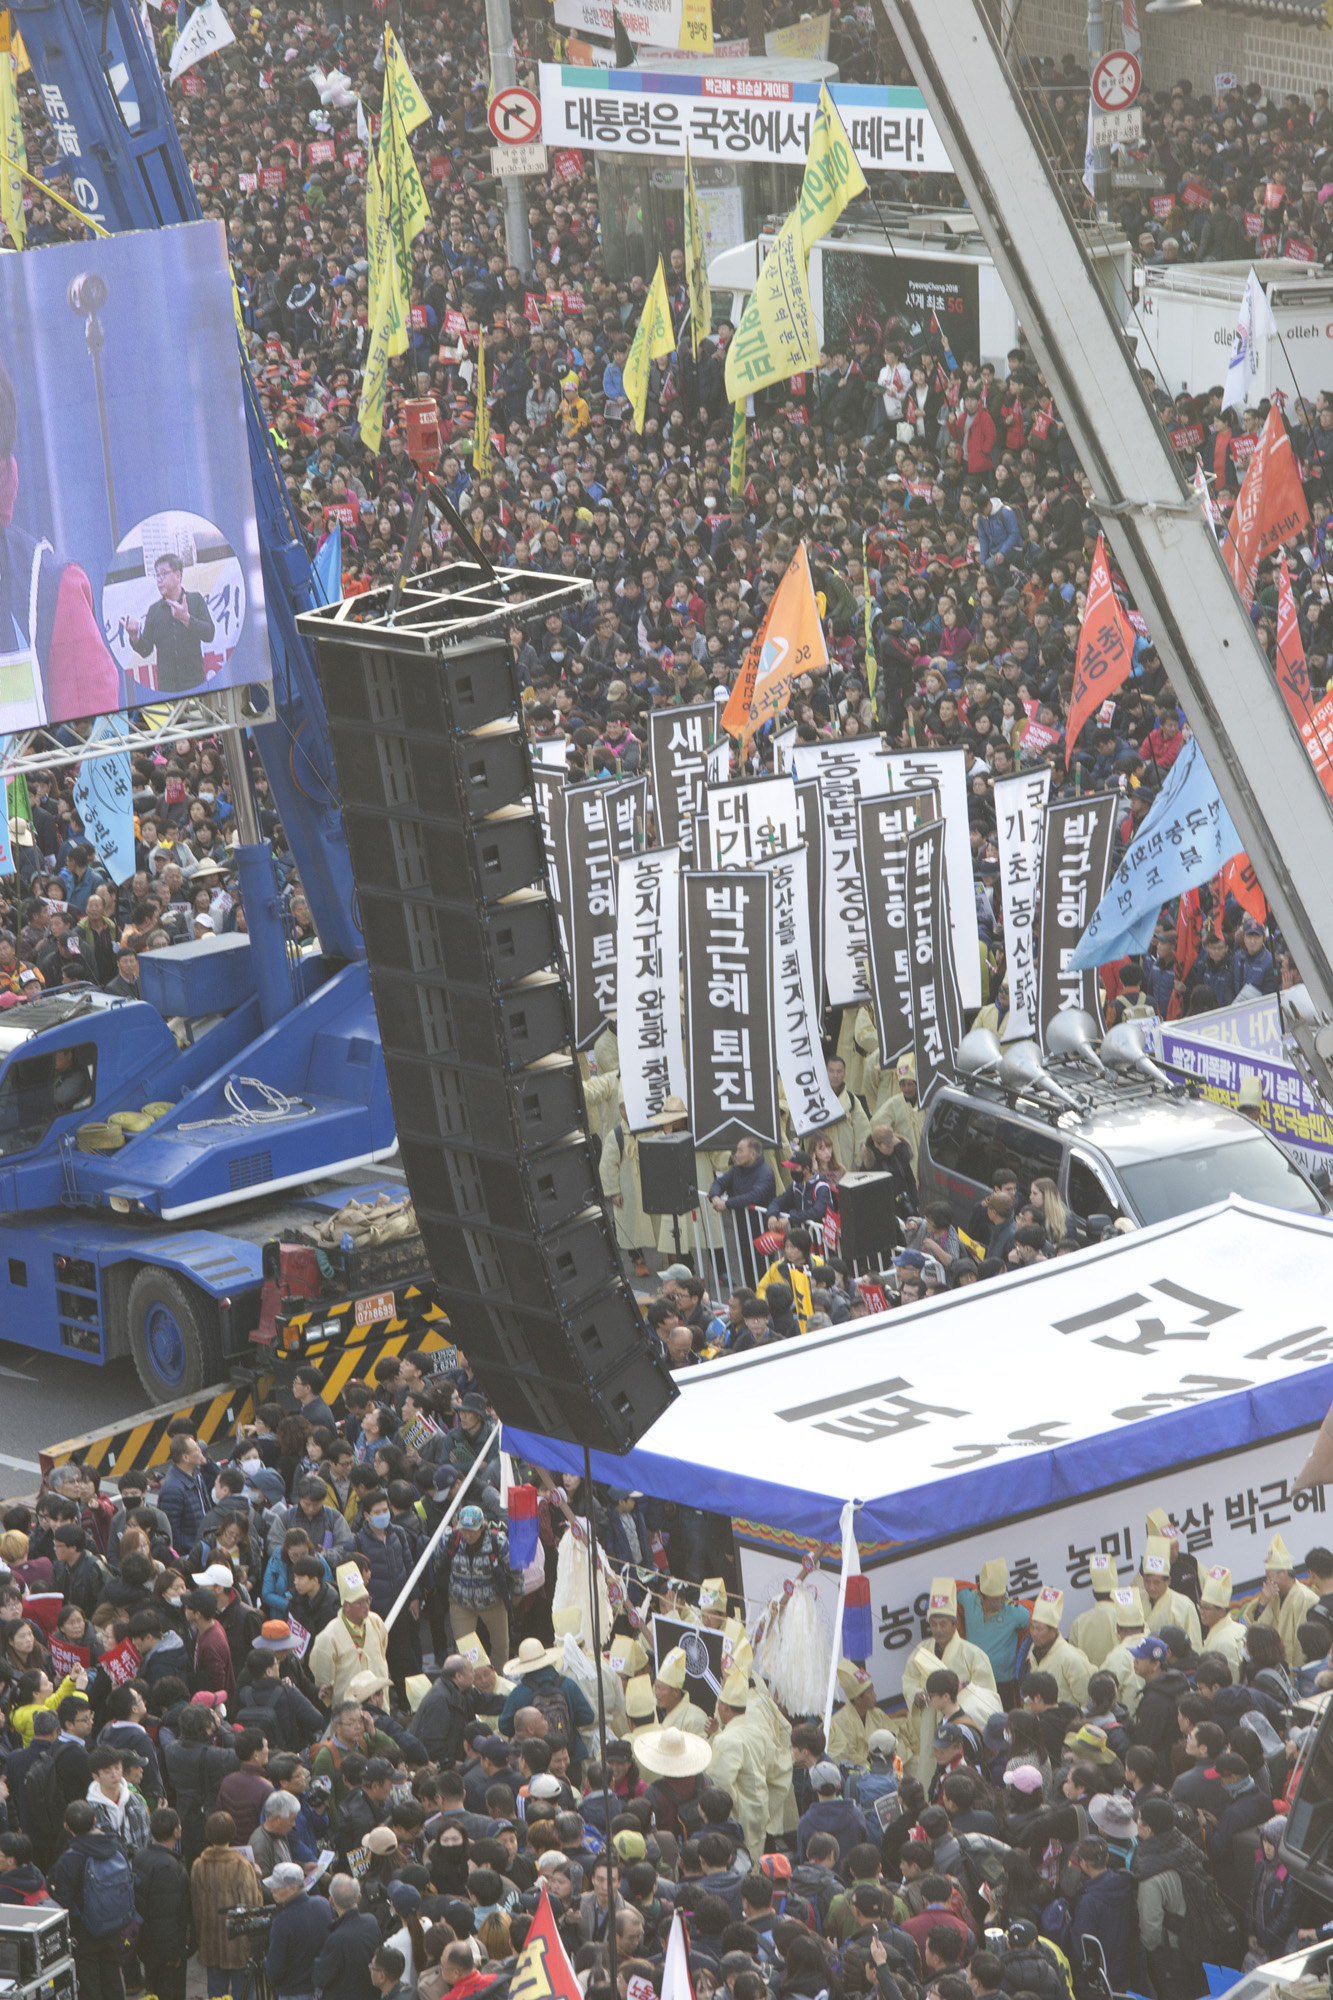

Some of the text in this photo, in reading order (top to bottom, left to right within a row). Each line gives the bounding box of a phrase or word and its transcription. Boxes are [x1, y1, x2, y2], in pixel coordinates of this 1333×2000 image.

[687, 21, 708, 40] 정의당
[763, 82, 790, 98] 게이트
[565, 97, 925, 162] 대통령은 국정에서 떼라!
[926, 293, 946, 311] 최초
[947, 297, 964, 313] 5G
[1143, 298, 1153, 315] kt
[1286, 324, 1319, 340] olleh
[668, 716, 706, 853] 새누리당
[816, 751, 862, 840] 농협법
[1056, 811, 1099, 930] 박근혜
[633, 860, 665, 979] 농지규제
[636, 986, 668, 1050] 완화
[706, 886, 755, 1112] 박근혜 퇴진
[771, 864, 797, 947] 농산물
[795, 1064, 830, 1123] 인상
[919, 977, 945, 1066] 퇴진
[1171, 1045, 1196, 1072] 쌀값
[1197, 1051, 1236, 1090] 대폭락!
[1276, 1073, 1300, 1107] 농민
[1066, 1527, 1135, 1591] 농민
[1225, 1479, 1326, 1536] 박근혜
